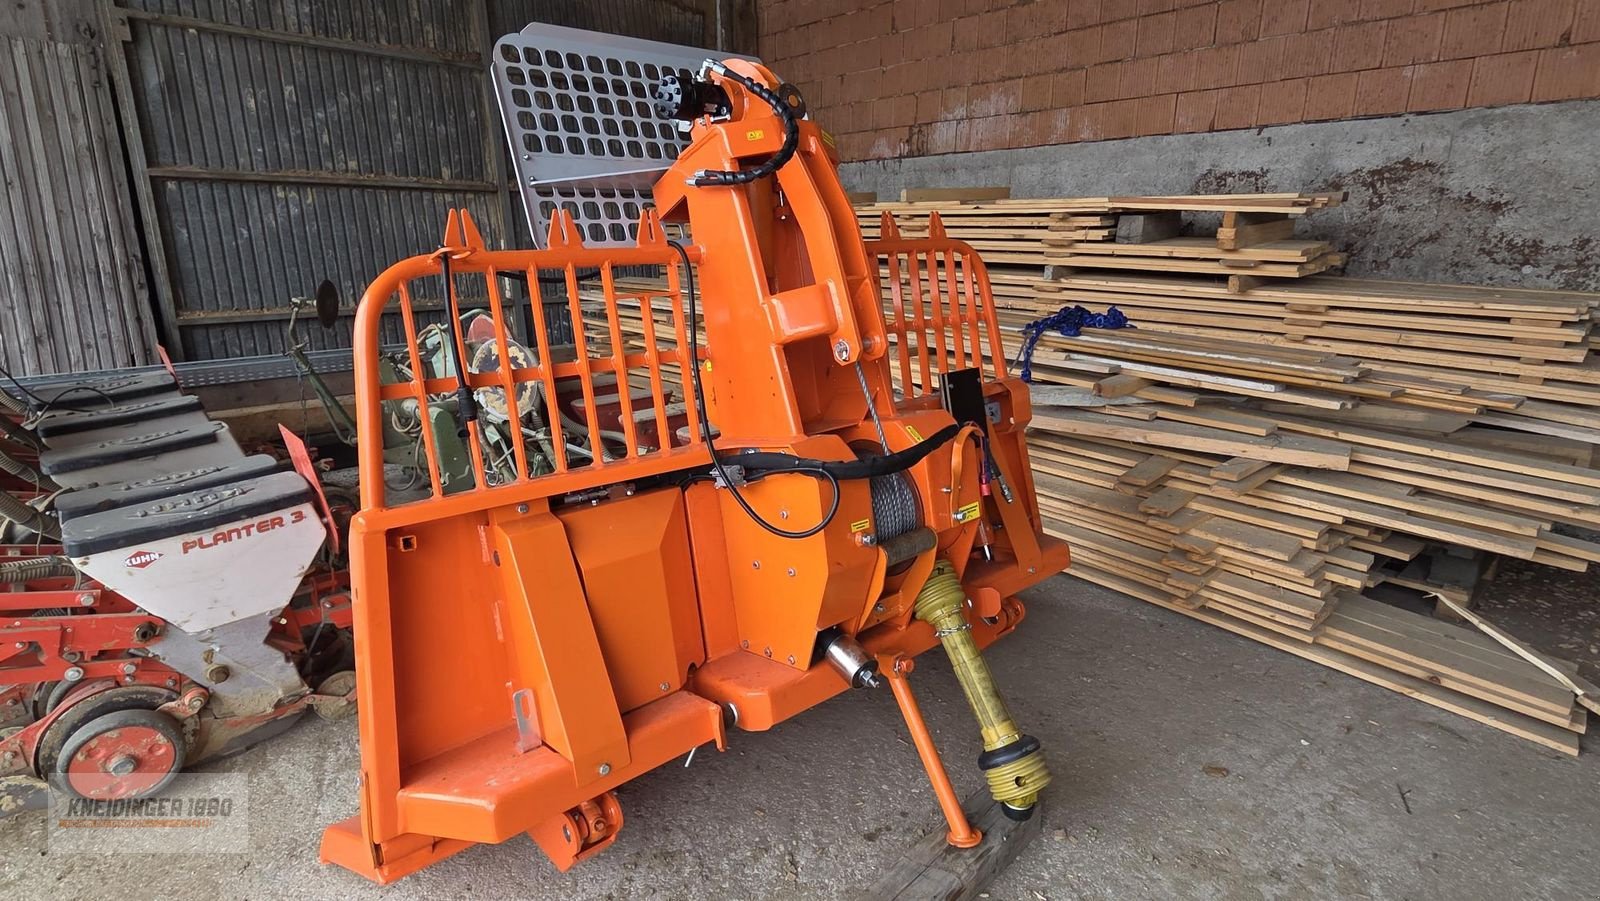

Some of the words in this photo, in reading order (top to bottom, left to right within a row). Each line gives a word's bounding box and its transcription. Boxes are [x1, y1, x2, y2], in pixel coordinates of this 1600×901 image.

[182, 516, 284, 554] PLANTER
[291, 510, 305, 524] 3
[124, 552, 160, 567] KUHN
